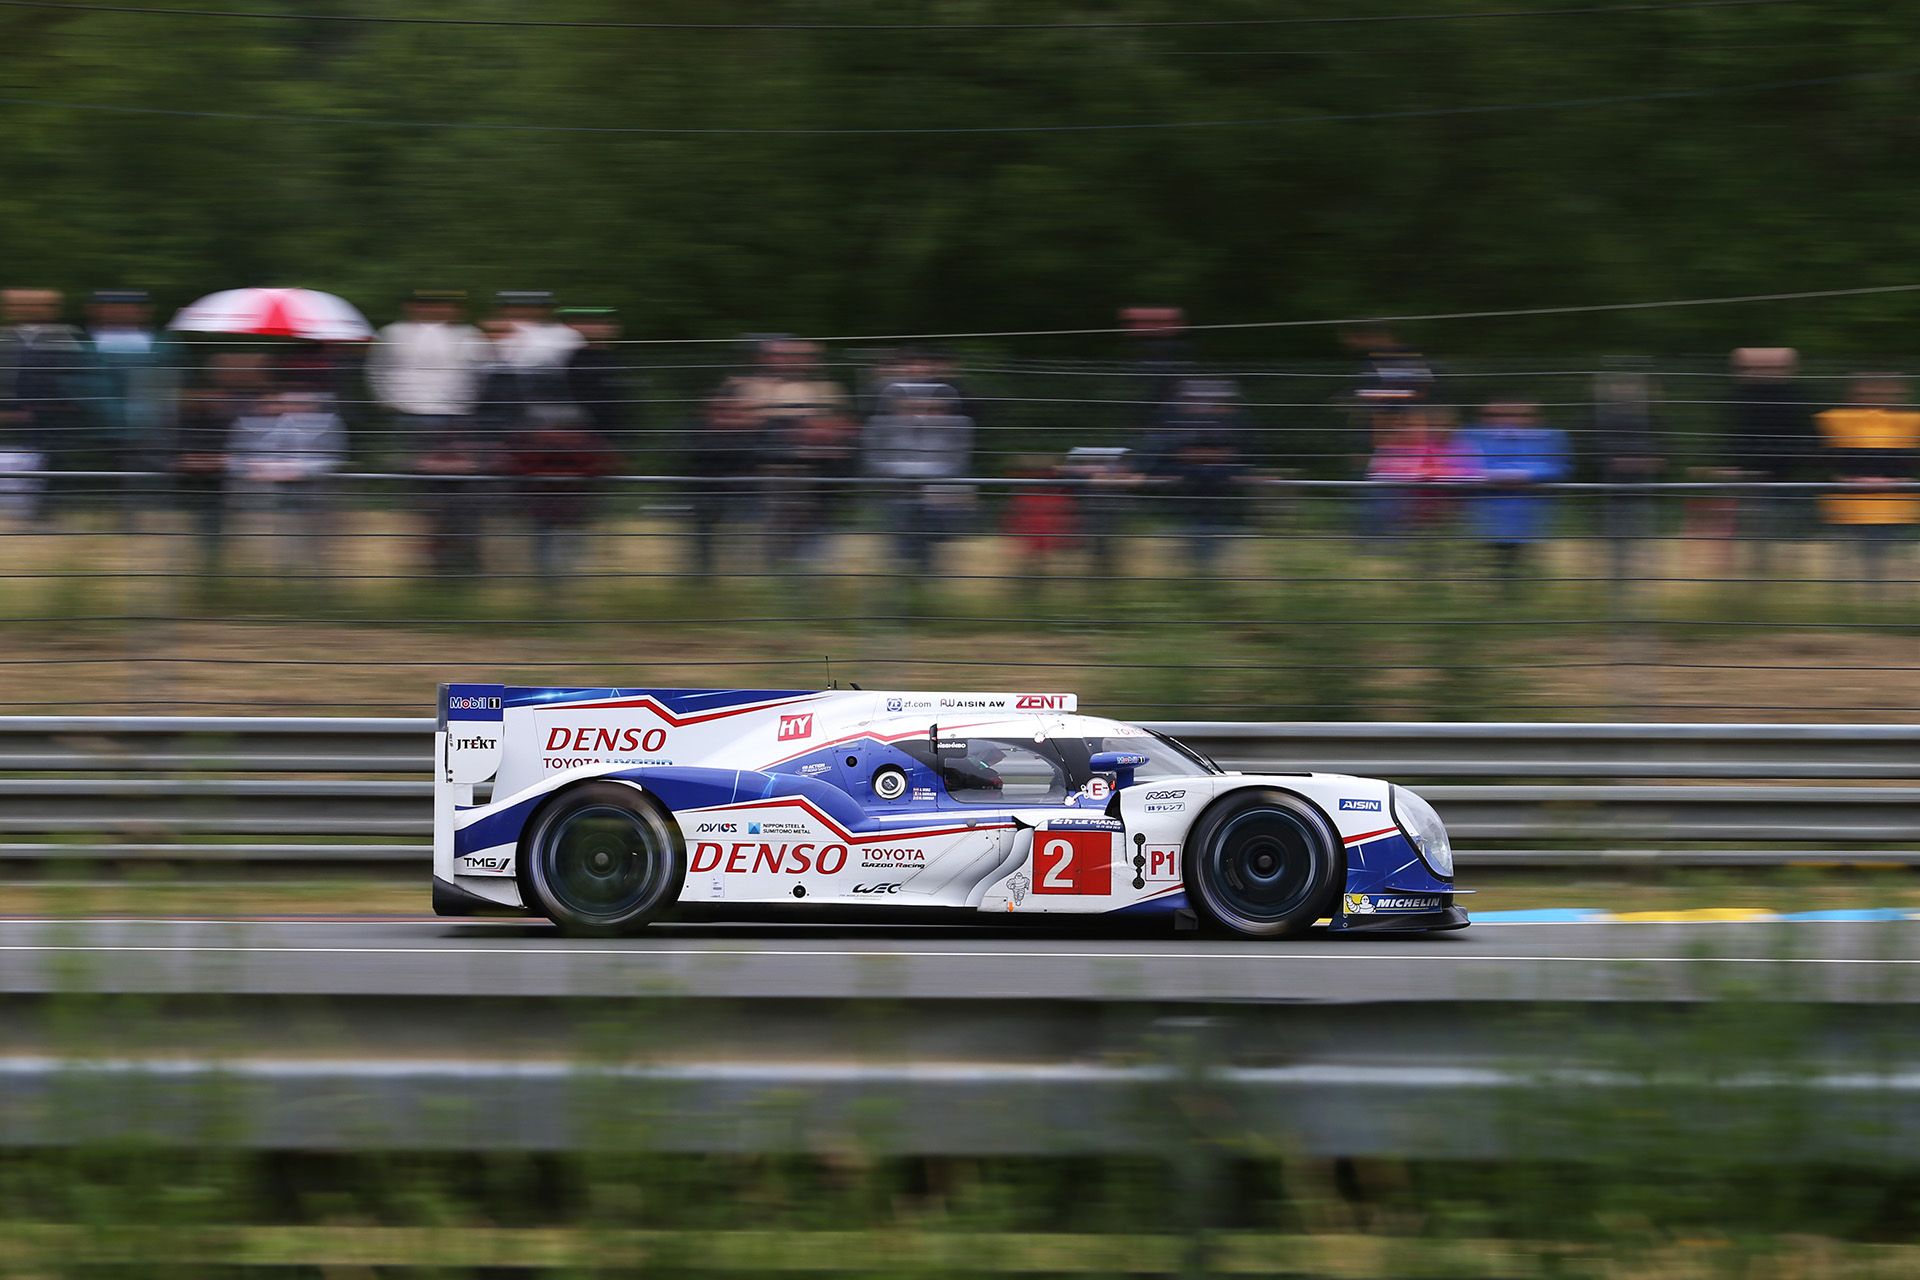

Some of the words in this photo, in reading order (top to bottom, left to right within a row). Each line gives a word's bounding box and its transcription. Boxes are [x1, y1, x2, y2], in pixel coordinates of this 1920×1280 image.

[450, 696, 487, 709] Mobil
[904, 700, 932, 708] zf.com
[1015, 695, 1068, 709] ZENT
[779, 715, 811, 737] HY
[456, 736, 497, 751] JTEKT
[545, 727, 667, 752] DENSO
[1092, 783, 1103, 796] E
[1145, 790, 1186, 800] RAYS
[1342, 800, 1379, 810] AISIN
[696, 823, 738, 833] ADVICS
[689, 842, 848, 875] DENSO
[862, 849, 925, 861] TOYOTA
[464, 857, 497, 868] TMG
[1043, 839, 1075, 888] 2
[1151, 850, 1175, 875] P1
[852, 882, 902, 894] WEC
[1376, 897, 1440, 908] MICHELIN
